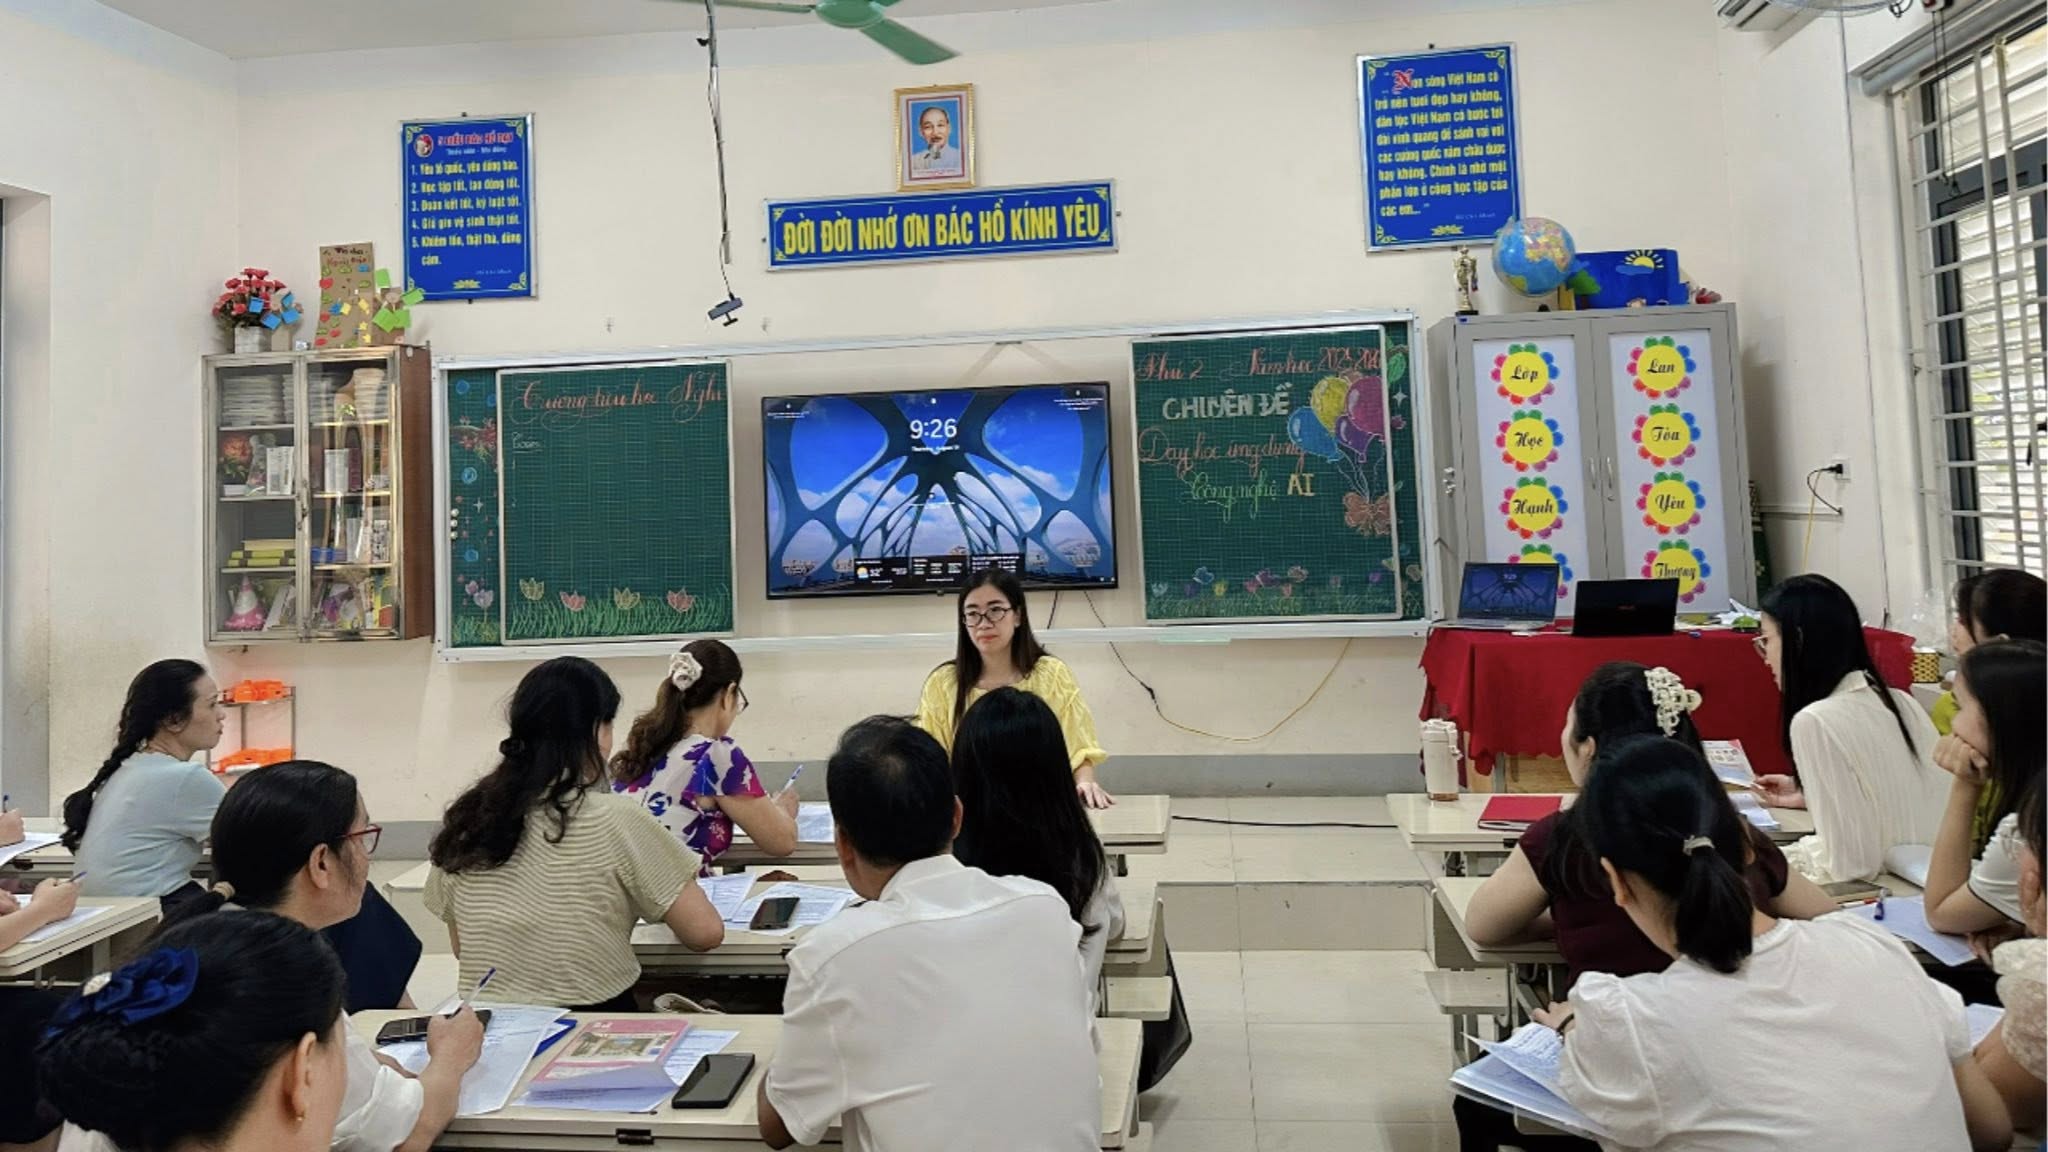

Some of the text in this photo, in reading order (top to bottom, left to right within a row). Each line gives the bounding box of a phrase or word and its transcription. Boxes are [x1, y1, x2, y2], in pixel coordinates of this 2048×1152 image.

[784, 197, 1099, 255] ĐỜI ĐỜI NHỚ ƠN BÁC HỒ KÍNH YÊU
[1648, 359, 1675, 374] Lan
[1162, 382, 1292, 421] CHUYÊN ĐỀ
[910, 418, 957, 439] 9:26
[1514, 431, 1543, 450] Học
[1287, 473, 1315, 497] AI
[1512, 499, 1553, 517] Hạnh
